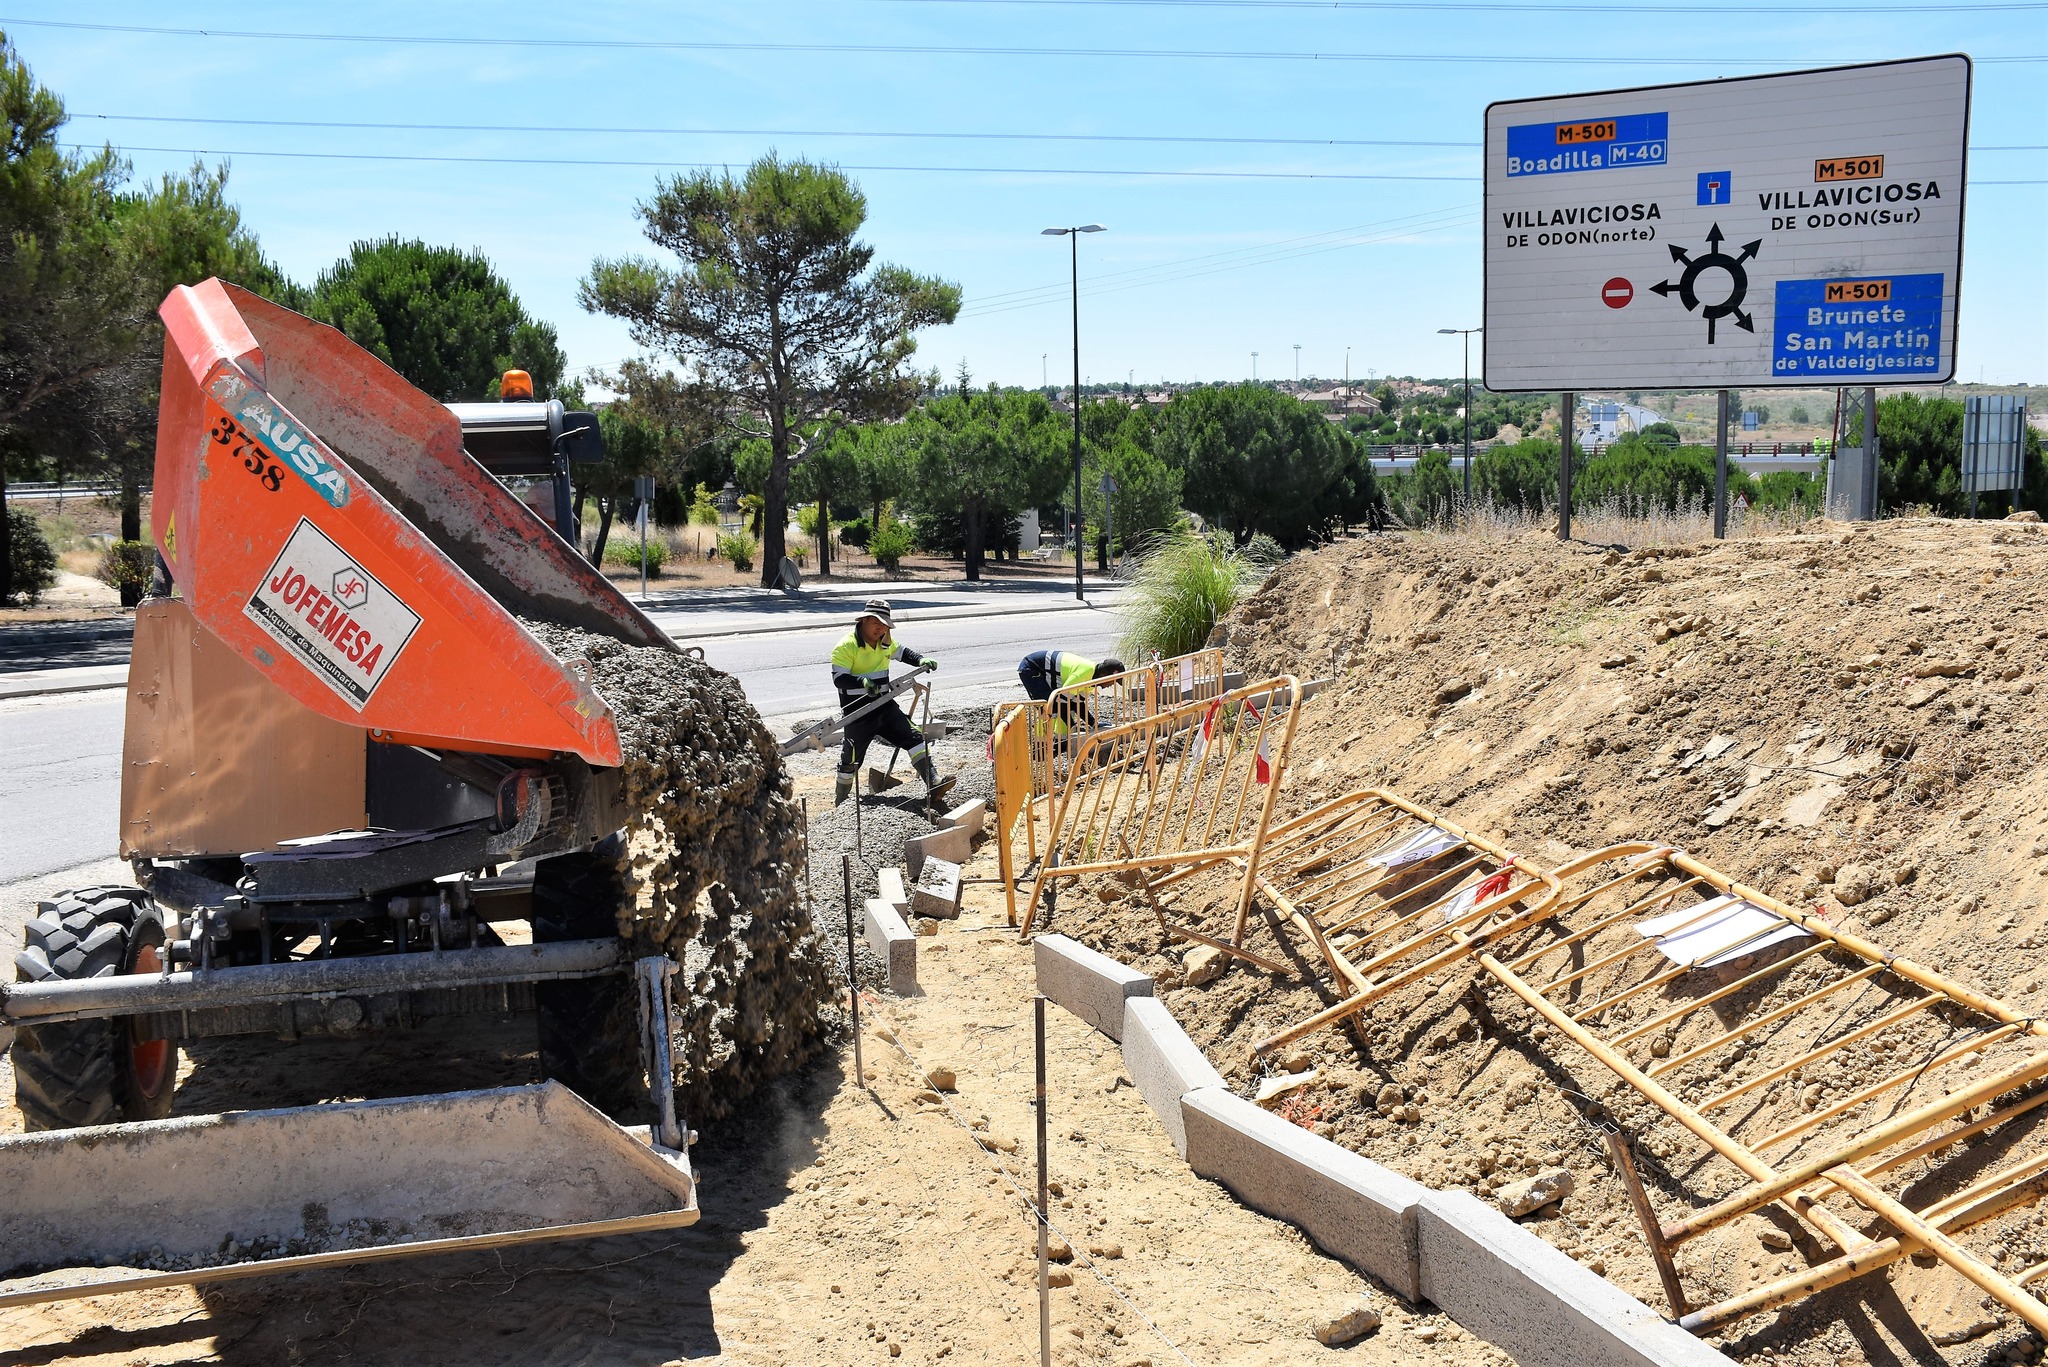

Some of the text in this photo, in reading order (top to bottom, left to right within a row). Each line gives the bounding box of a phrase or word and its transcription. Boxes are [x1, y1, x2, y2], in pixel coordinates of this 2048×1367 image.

[1559, 123, 1614, 142] M-501
[1507, 144, 1662, 174] Boadilla M-40
[1819, 160, 1880, 178] M-501
[1758, 181, 1941, 211] VILLAVICIOSA
[1503, 203, 1662, 229] VILLAVICIOSA
[1771, 207, 1921, 231] DE ODON(Sur)
[1507, 226, 1656, 248] DE ODON(norte)
[1828, 283, 1888, 300] M-501
[1807, 304, 1906, 326] Brunete
[1785, 332, 1832, 351] San
[1775, 353, 1935, 371] de Valdeiglesias
[211, 416, 285, 492] 3758
[241, 403, 347, 502] AUSA
[270, 565, 384, 677] JOFEMESA
[262, 606, 357, 691] Alquiler de Maquinaria
